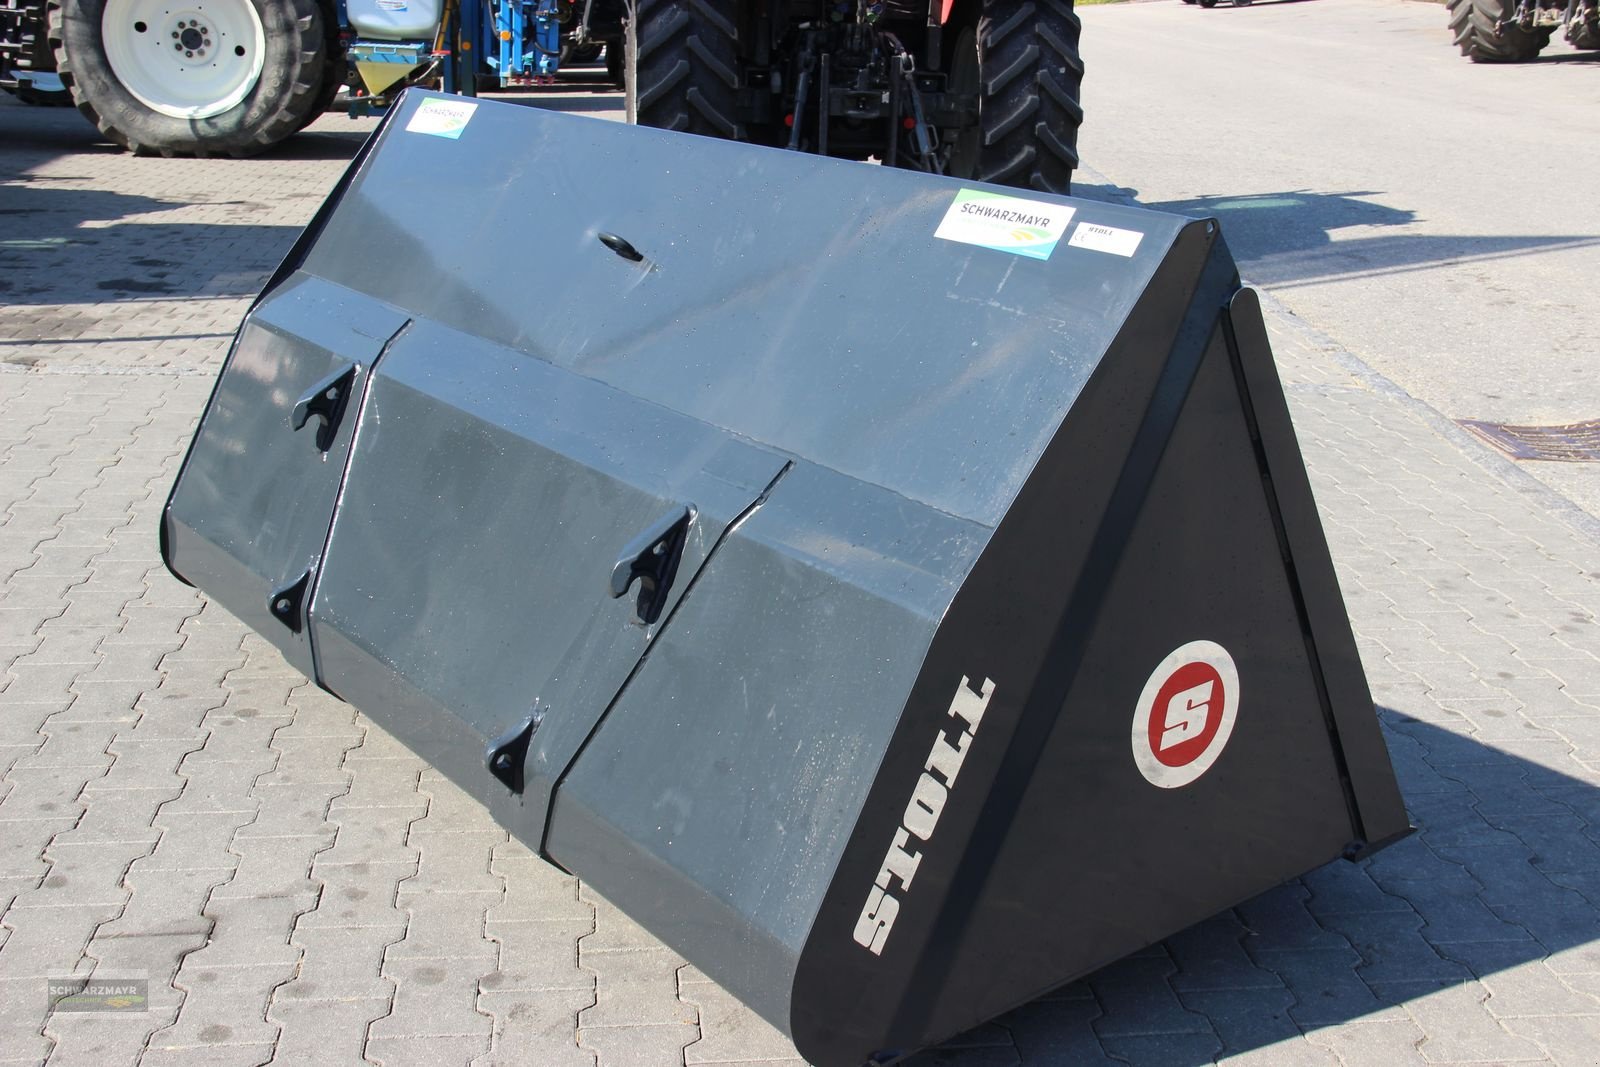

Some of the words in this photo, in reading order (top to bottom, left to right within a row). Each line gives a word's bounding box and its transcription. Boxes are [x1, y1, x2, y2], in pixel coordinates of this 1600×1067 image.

[960, 203, 1051, 228] SCHWARZMAYR
[1088, 226, 1114, 236] STOLL
[1159, 679, 1214, 751] S
[853, 674, 996, 957] STOLL
